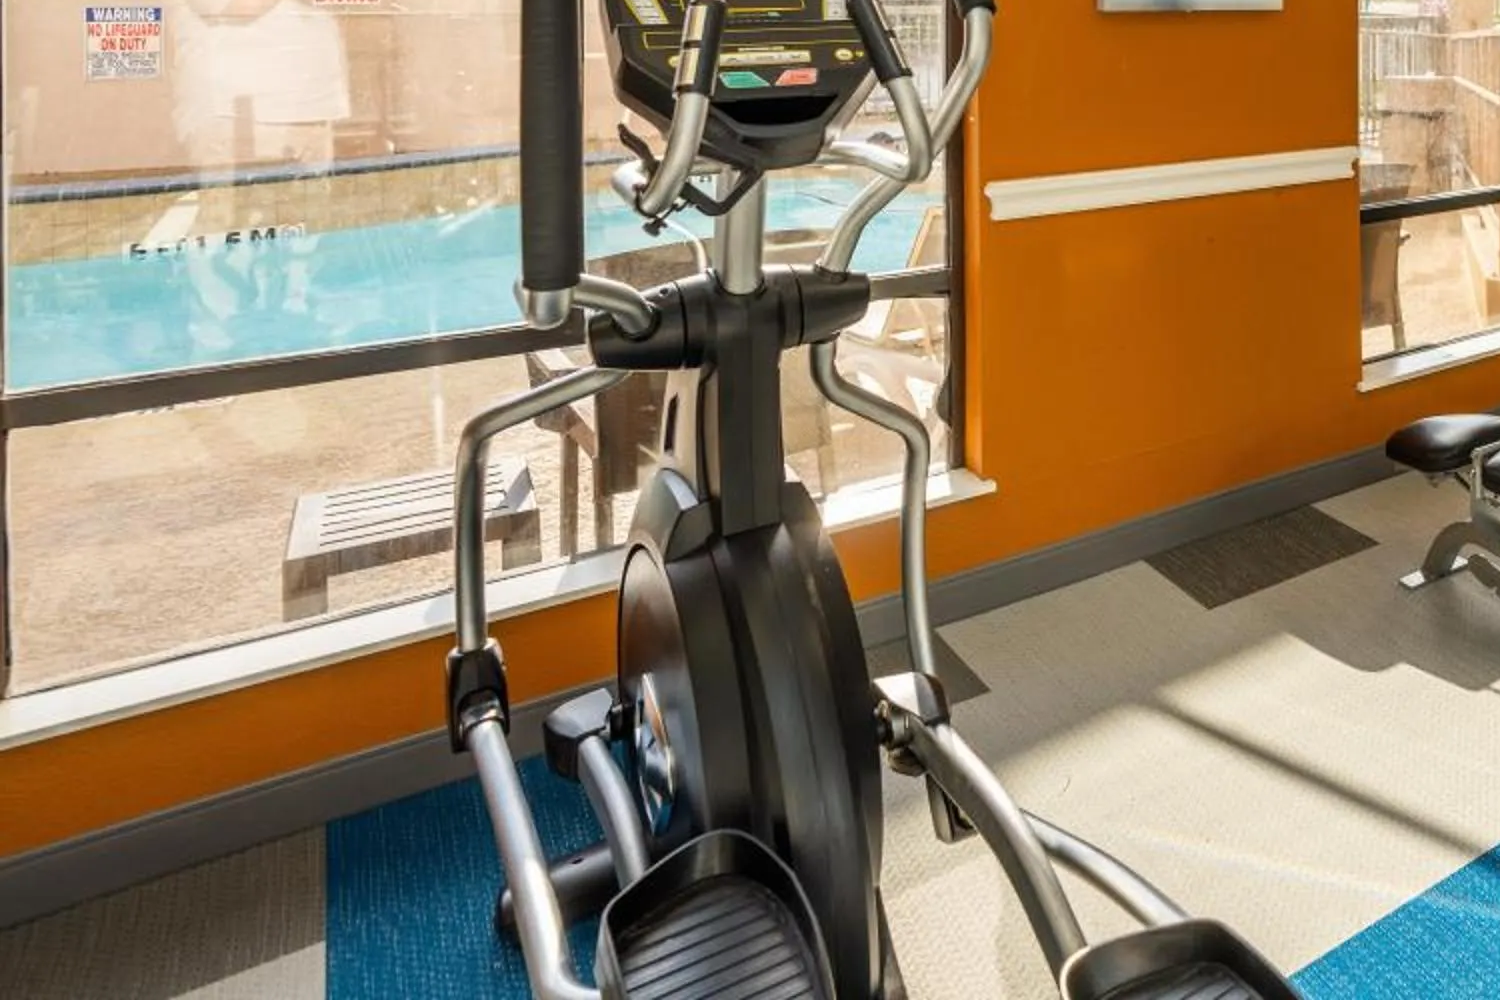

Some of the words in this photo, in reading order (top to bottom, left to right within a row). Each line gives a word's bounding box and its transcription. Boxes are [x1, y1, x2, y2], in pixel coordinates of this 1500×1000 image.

[93, 7, 156, 21] WARNING
[88, 24, 102, 36] NO
[105, 24, 161, 36] LIFEGUARD
[101, 37, 117, 50] ON
[120, 37, 147, 50] DUTY
